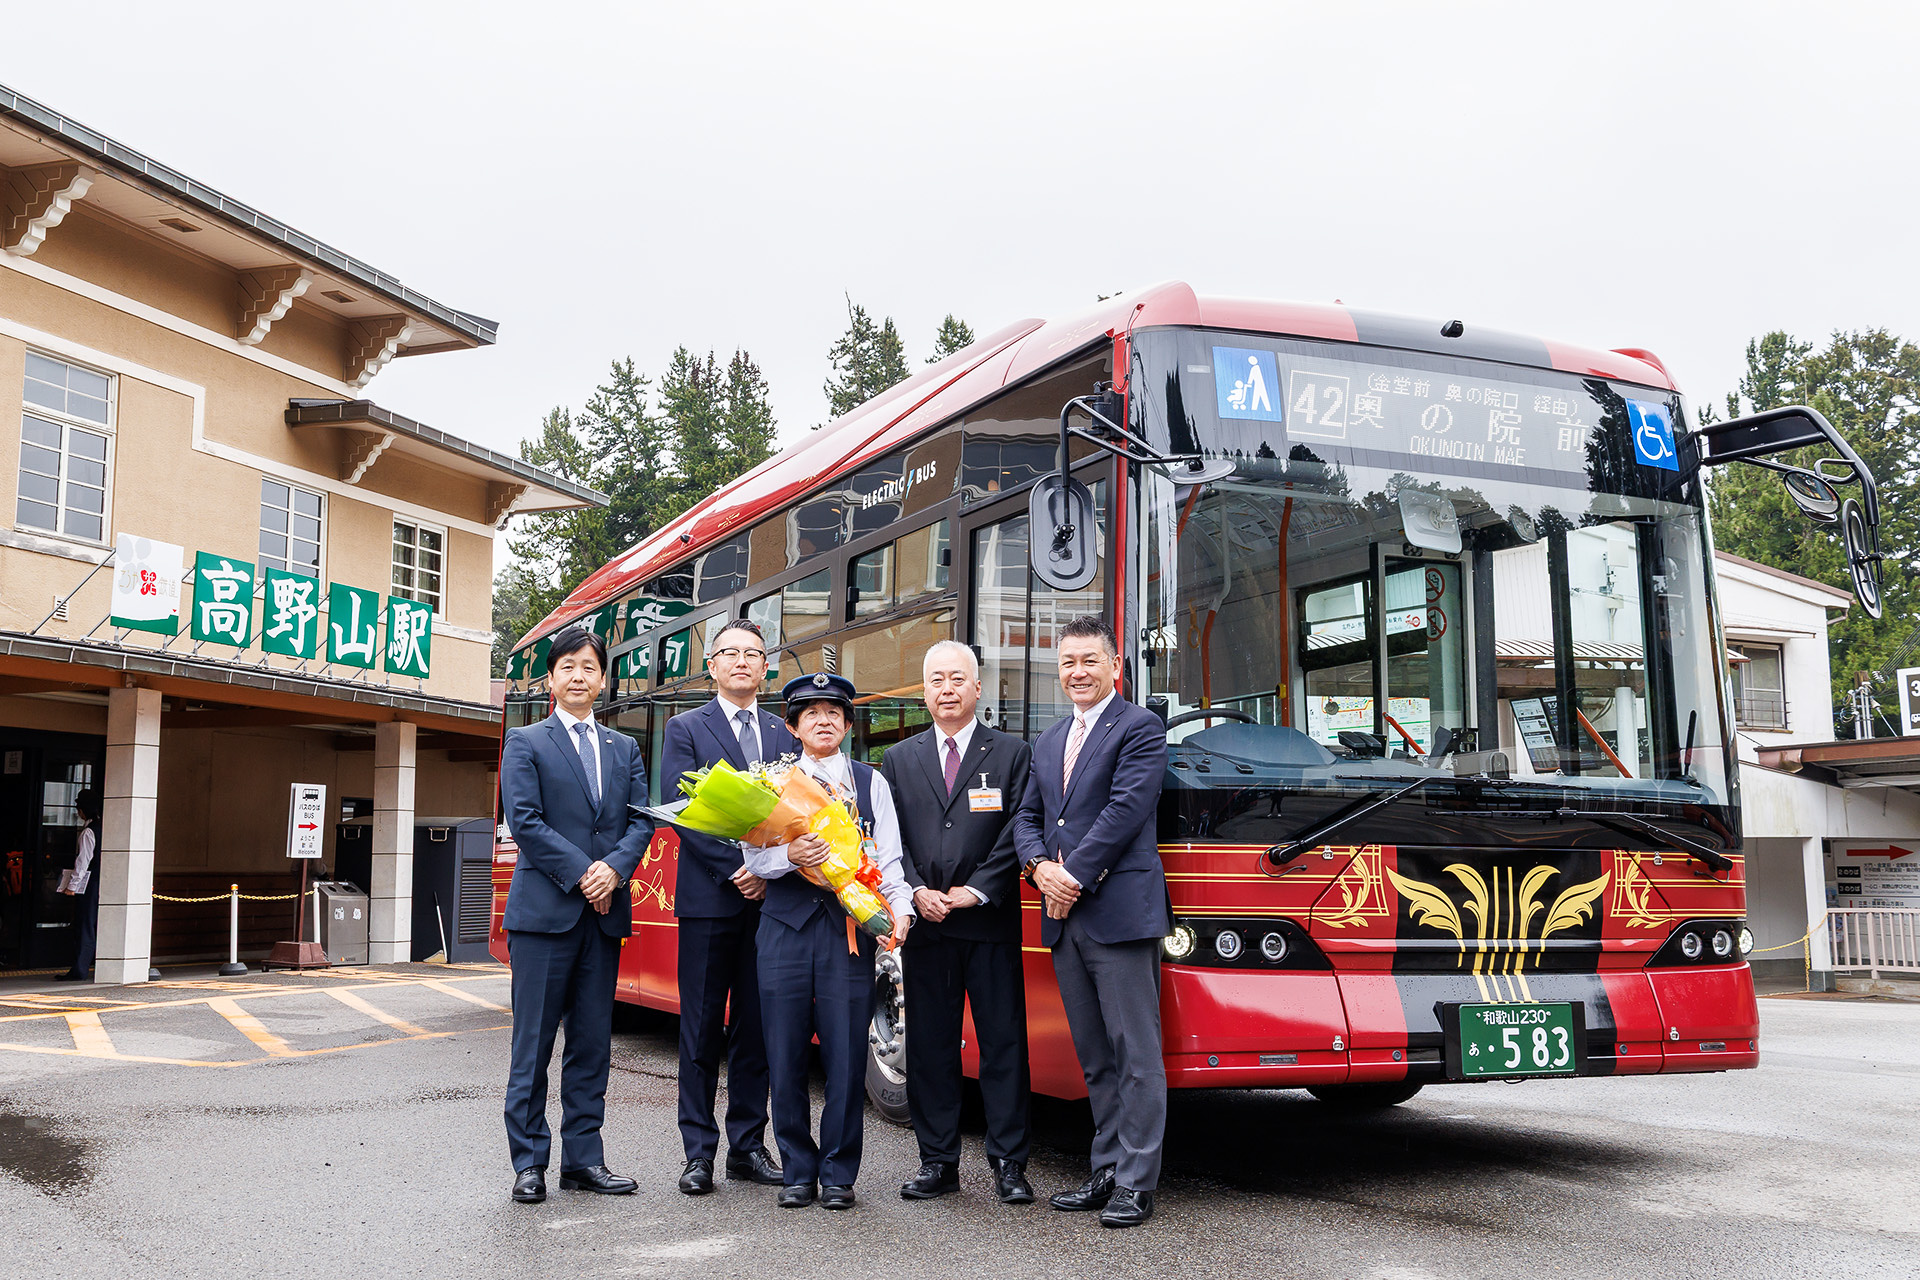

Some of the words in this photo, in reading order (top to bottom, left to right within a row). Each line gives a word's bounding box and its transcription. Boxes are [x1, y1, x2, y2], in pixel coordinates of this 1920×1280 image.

[1293, 383, 1343, 427] 42
[1349, 391, 1590, 453] 奥の院前
[1409, 435, 1485, 462] OKUNOIN
[1494, 446, 1526, 466] MAE
[862, 475, 905, 511] ELECTRIC
[915, 460, 937, 485] BUS
[199, 560, 429, 673] 高野山駅
[299, 803, 321, 812] バスのりば
[1482, 1009, 1547, 1025] 和歌山230
[1468, 1042, 1480, 1057] あ
